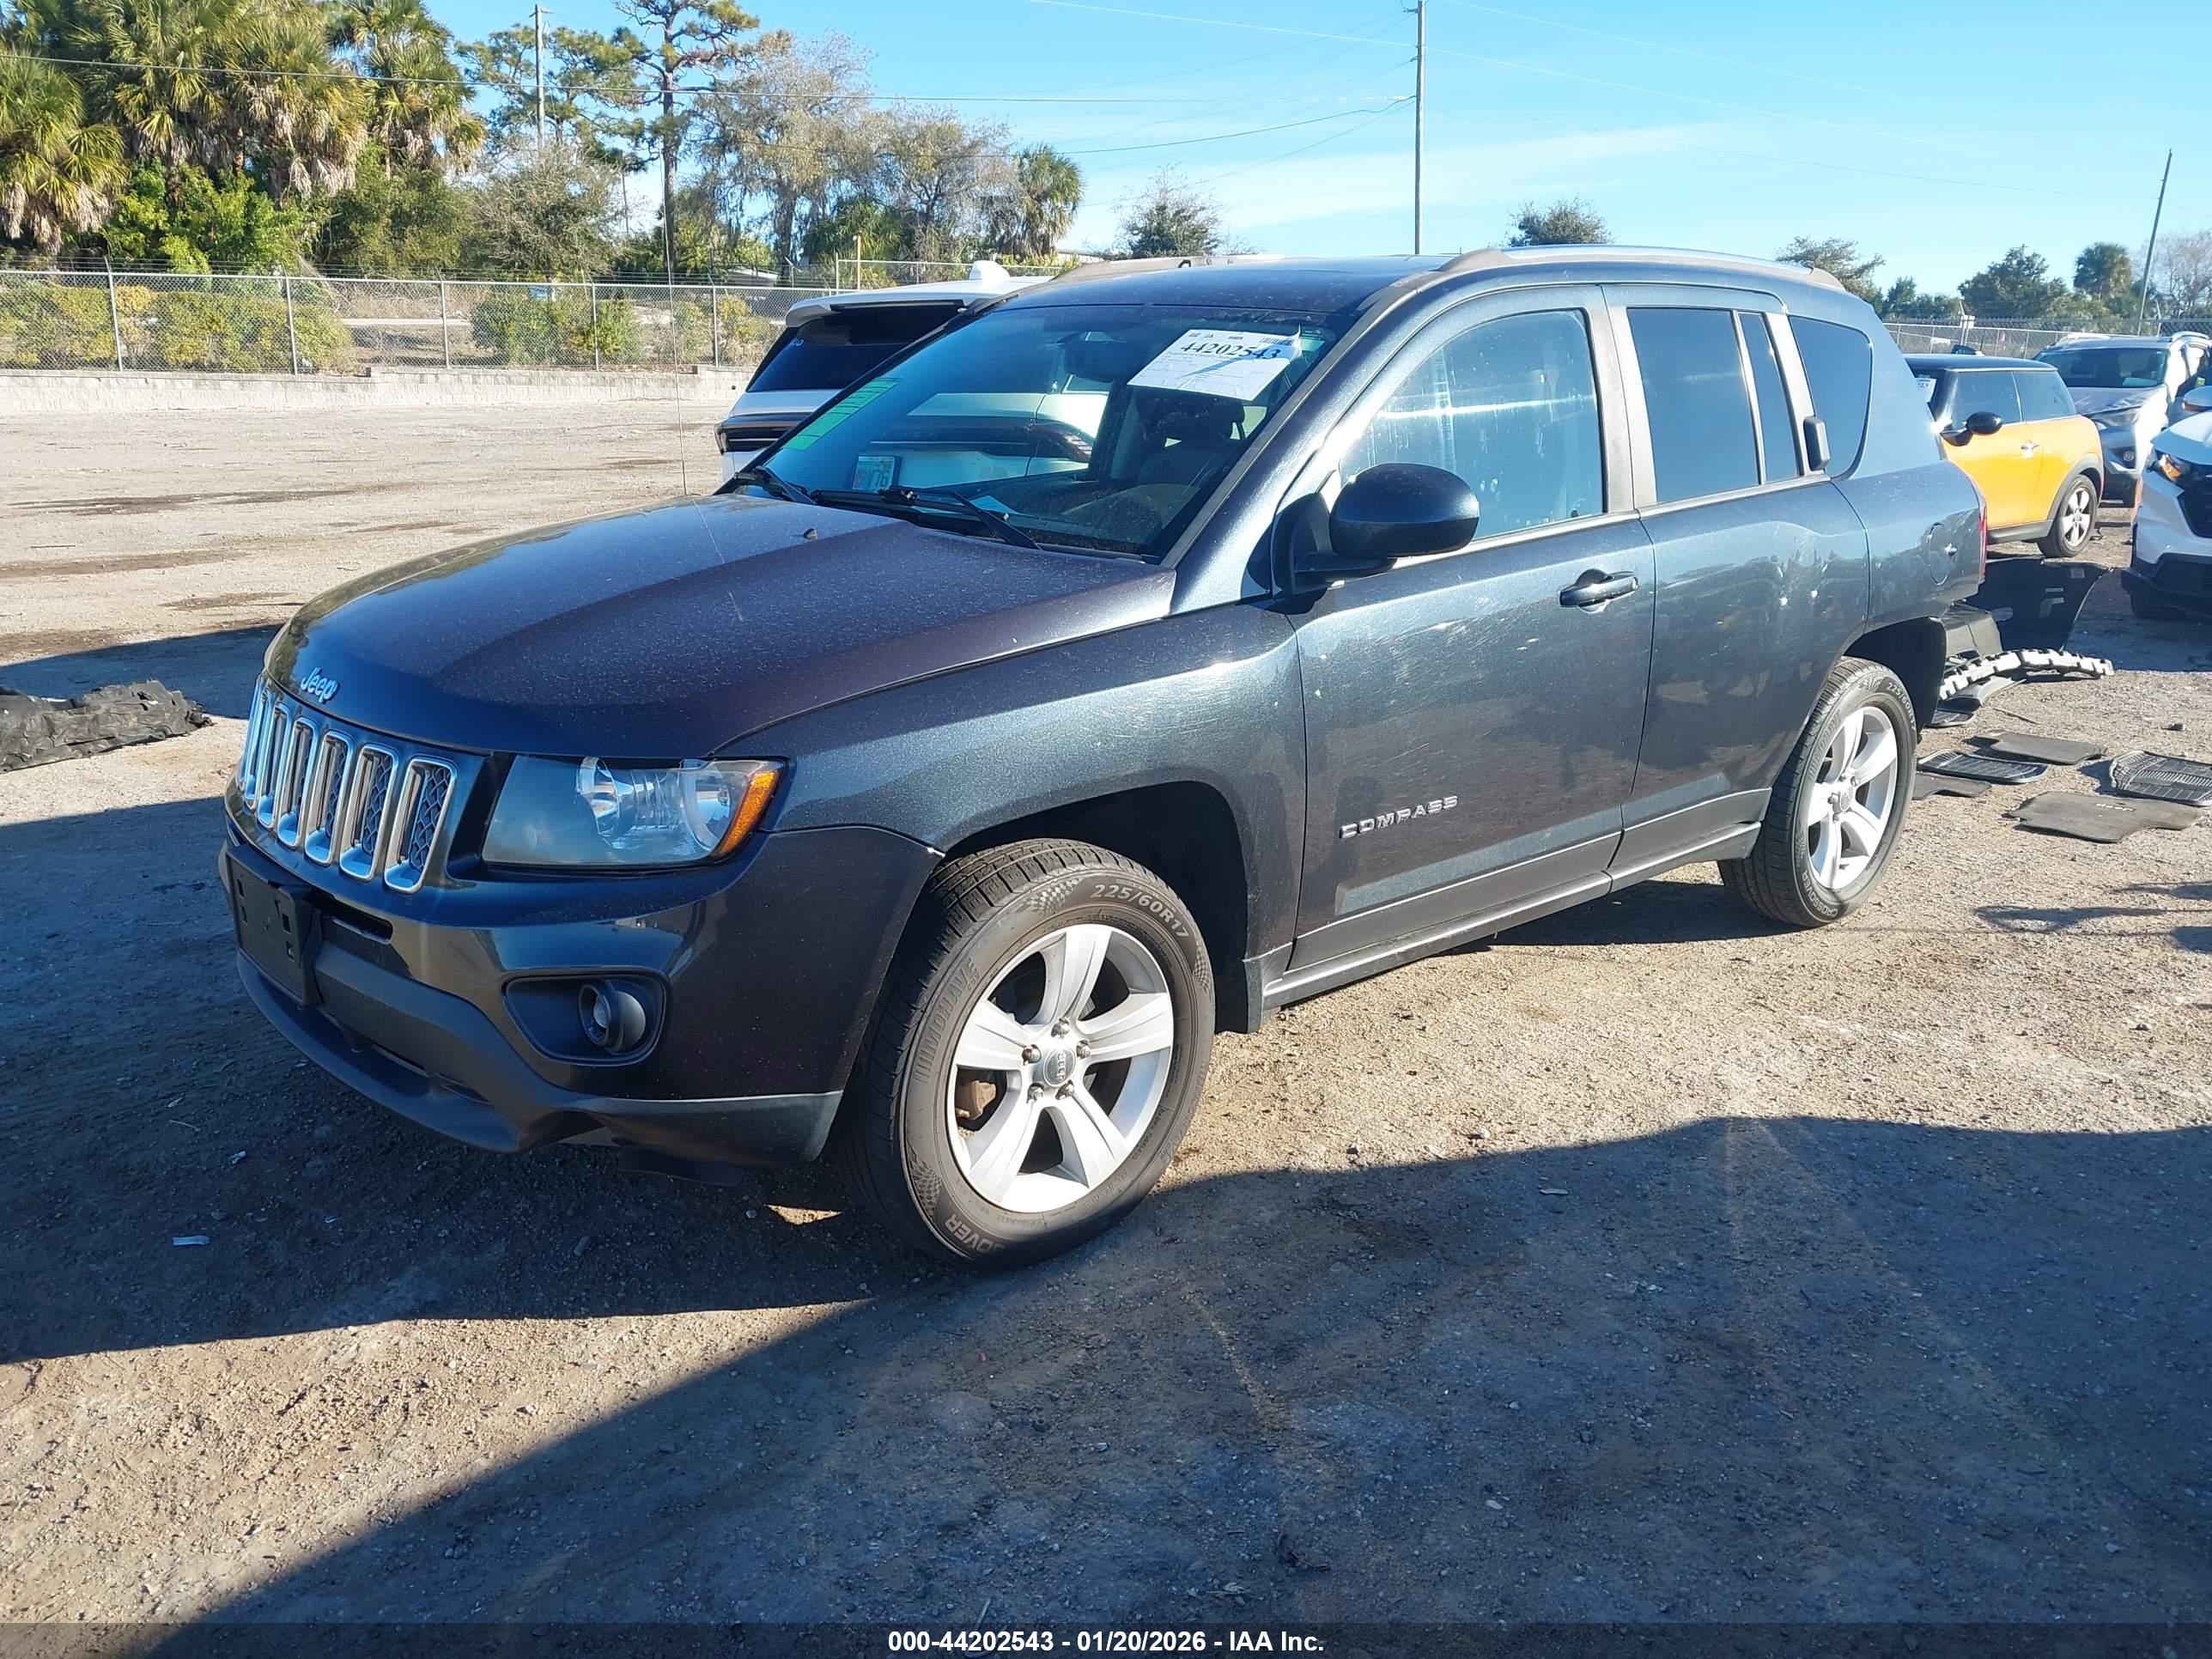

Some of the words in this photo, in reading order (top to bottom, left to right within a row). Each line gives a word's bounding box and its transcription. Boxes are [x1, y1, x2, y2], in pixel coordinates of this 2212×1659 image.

[1181, 342, 1281, 359] 44202543
[301, 667, 339, 704] Jeep
[1340, 795, 1458, 839] COMPASS
[1090, 884, 1189, 937] 225/60R17
[1802, 870, 1838, 917] CROSSOVER
